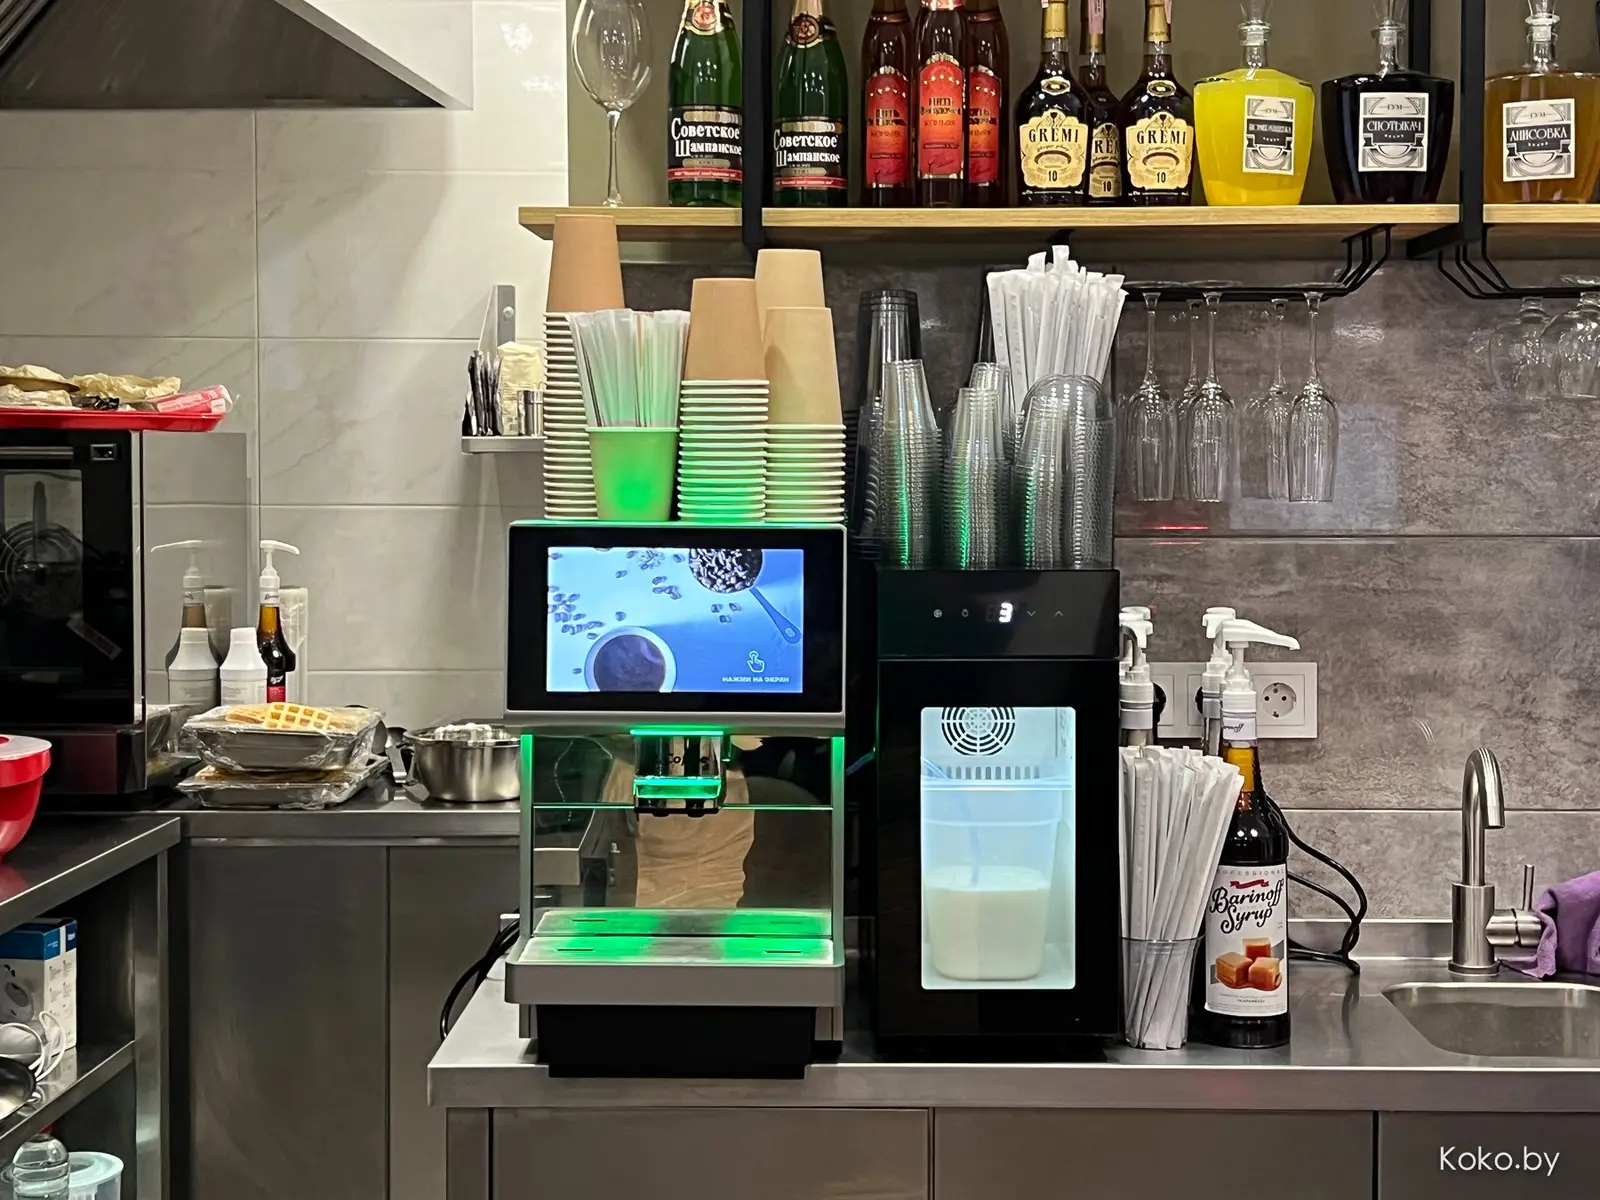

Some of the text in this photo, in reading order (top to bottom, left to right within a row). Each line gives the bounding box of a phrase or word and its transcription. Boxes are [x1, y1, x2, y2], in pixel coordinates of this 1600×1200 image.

[671, 117, 741, 141] Советское
[1028, 127, 1079, 143] GREMI
[1136, 129, 1187, 145] GREMI
[1509, 126, 1568, 142] АНИСОВКА
[675, 139, 742, 157] Шампанское
[773, 129, 838, 151] Советское
[776, 150, 840, 167] Шампанское
[1048, 170, 1058, 182] 10
[1156, 171, 1167, 183] 10
[1102, 180, 1112, 193] 10
[1209, 878, 1284, 914] Barinoff
[1220, 904, 1272, 934] Syrup
